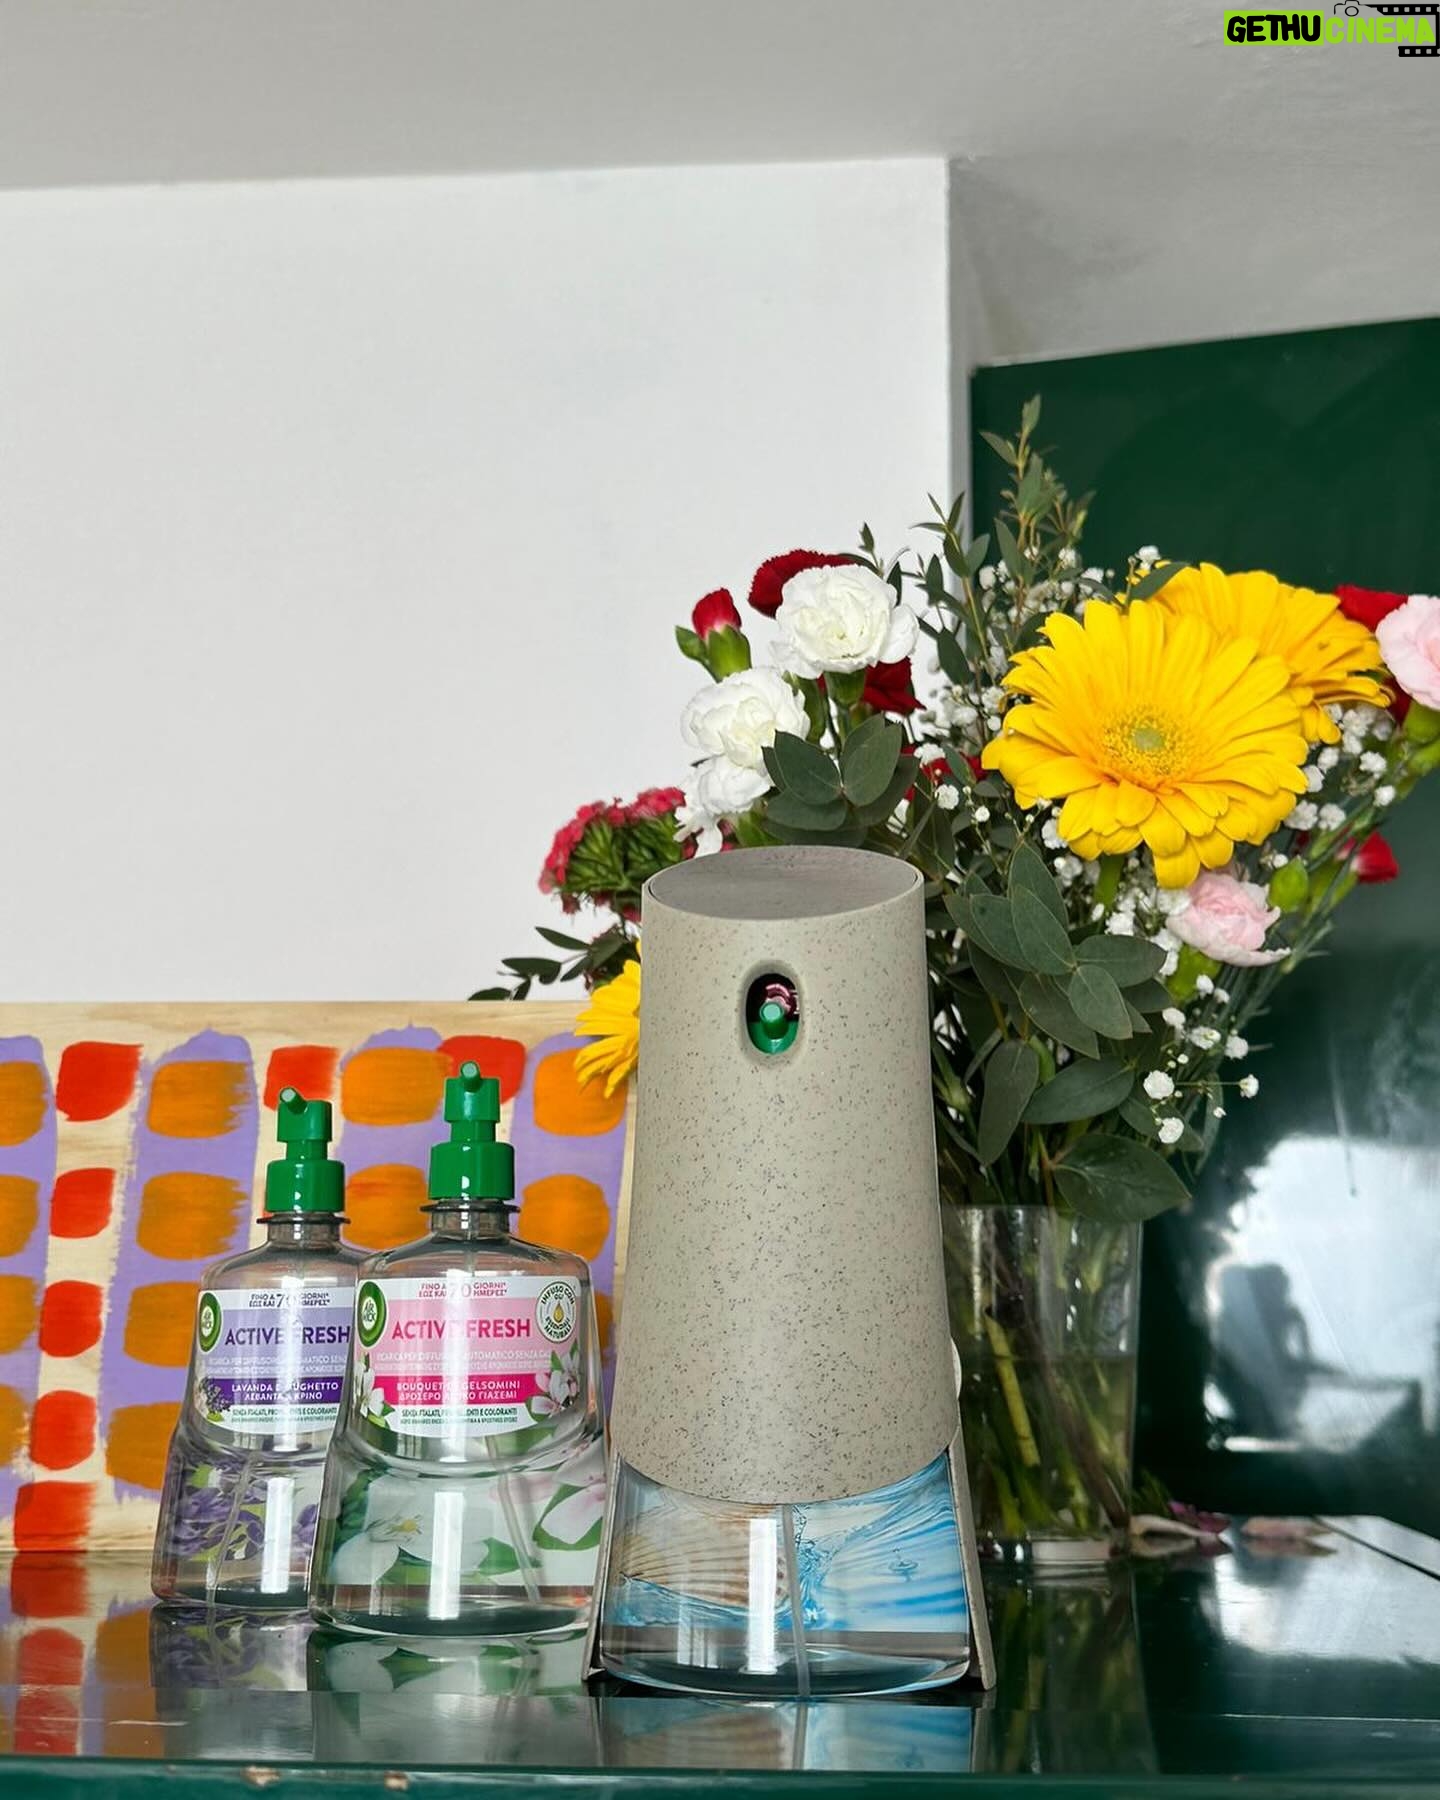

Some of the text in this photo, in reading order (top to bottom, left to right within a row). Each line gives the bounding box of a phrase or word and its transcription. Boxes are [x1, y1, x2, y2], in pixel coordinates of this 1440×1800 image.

[225, 1327, 285, 1346] ACTIVE
[392, 1319, 531, 1339] ACTIV FRESH
[231, 1382, 273, 1392] LAVANDA
[284, 1380, 339, 1392] UGHETTO
[397, 1382, 443, 1392] BOUQUET
[462, 1380, 520, 1392] GELSOMINI
